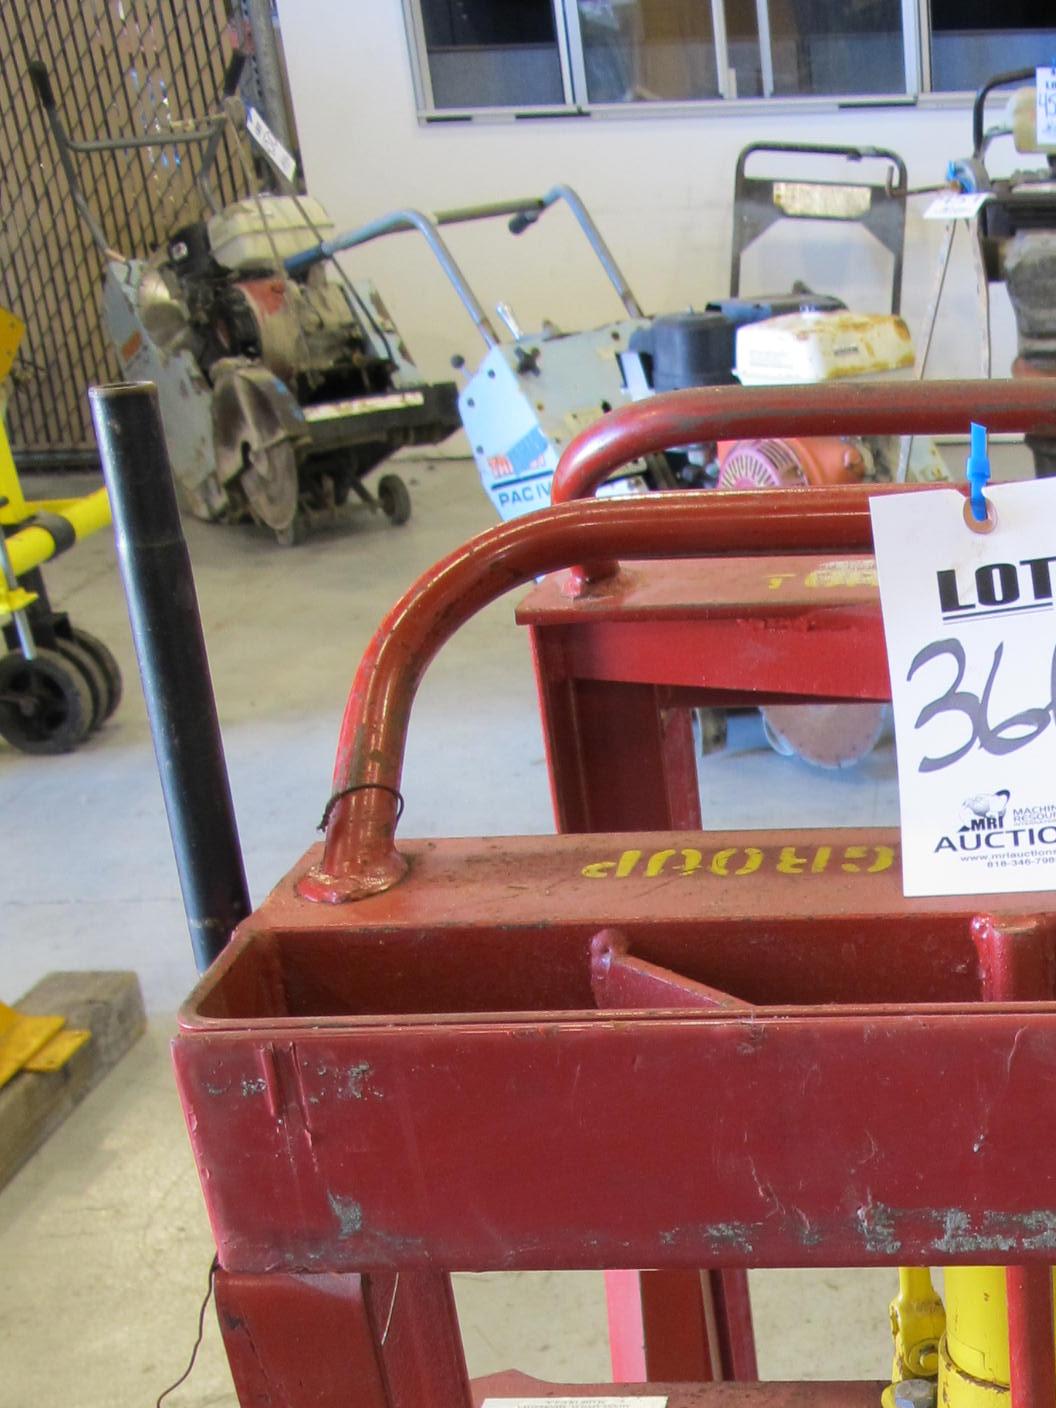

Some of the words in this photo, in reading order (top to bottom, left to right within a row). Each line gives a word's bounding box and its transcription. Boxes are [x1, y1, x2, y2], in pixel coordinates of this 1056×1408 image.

[498, 486, 534, 507] PAC
[970, 815, 1005, 832] MRI
[581, 846, 895, 879] GROUP
